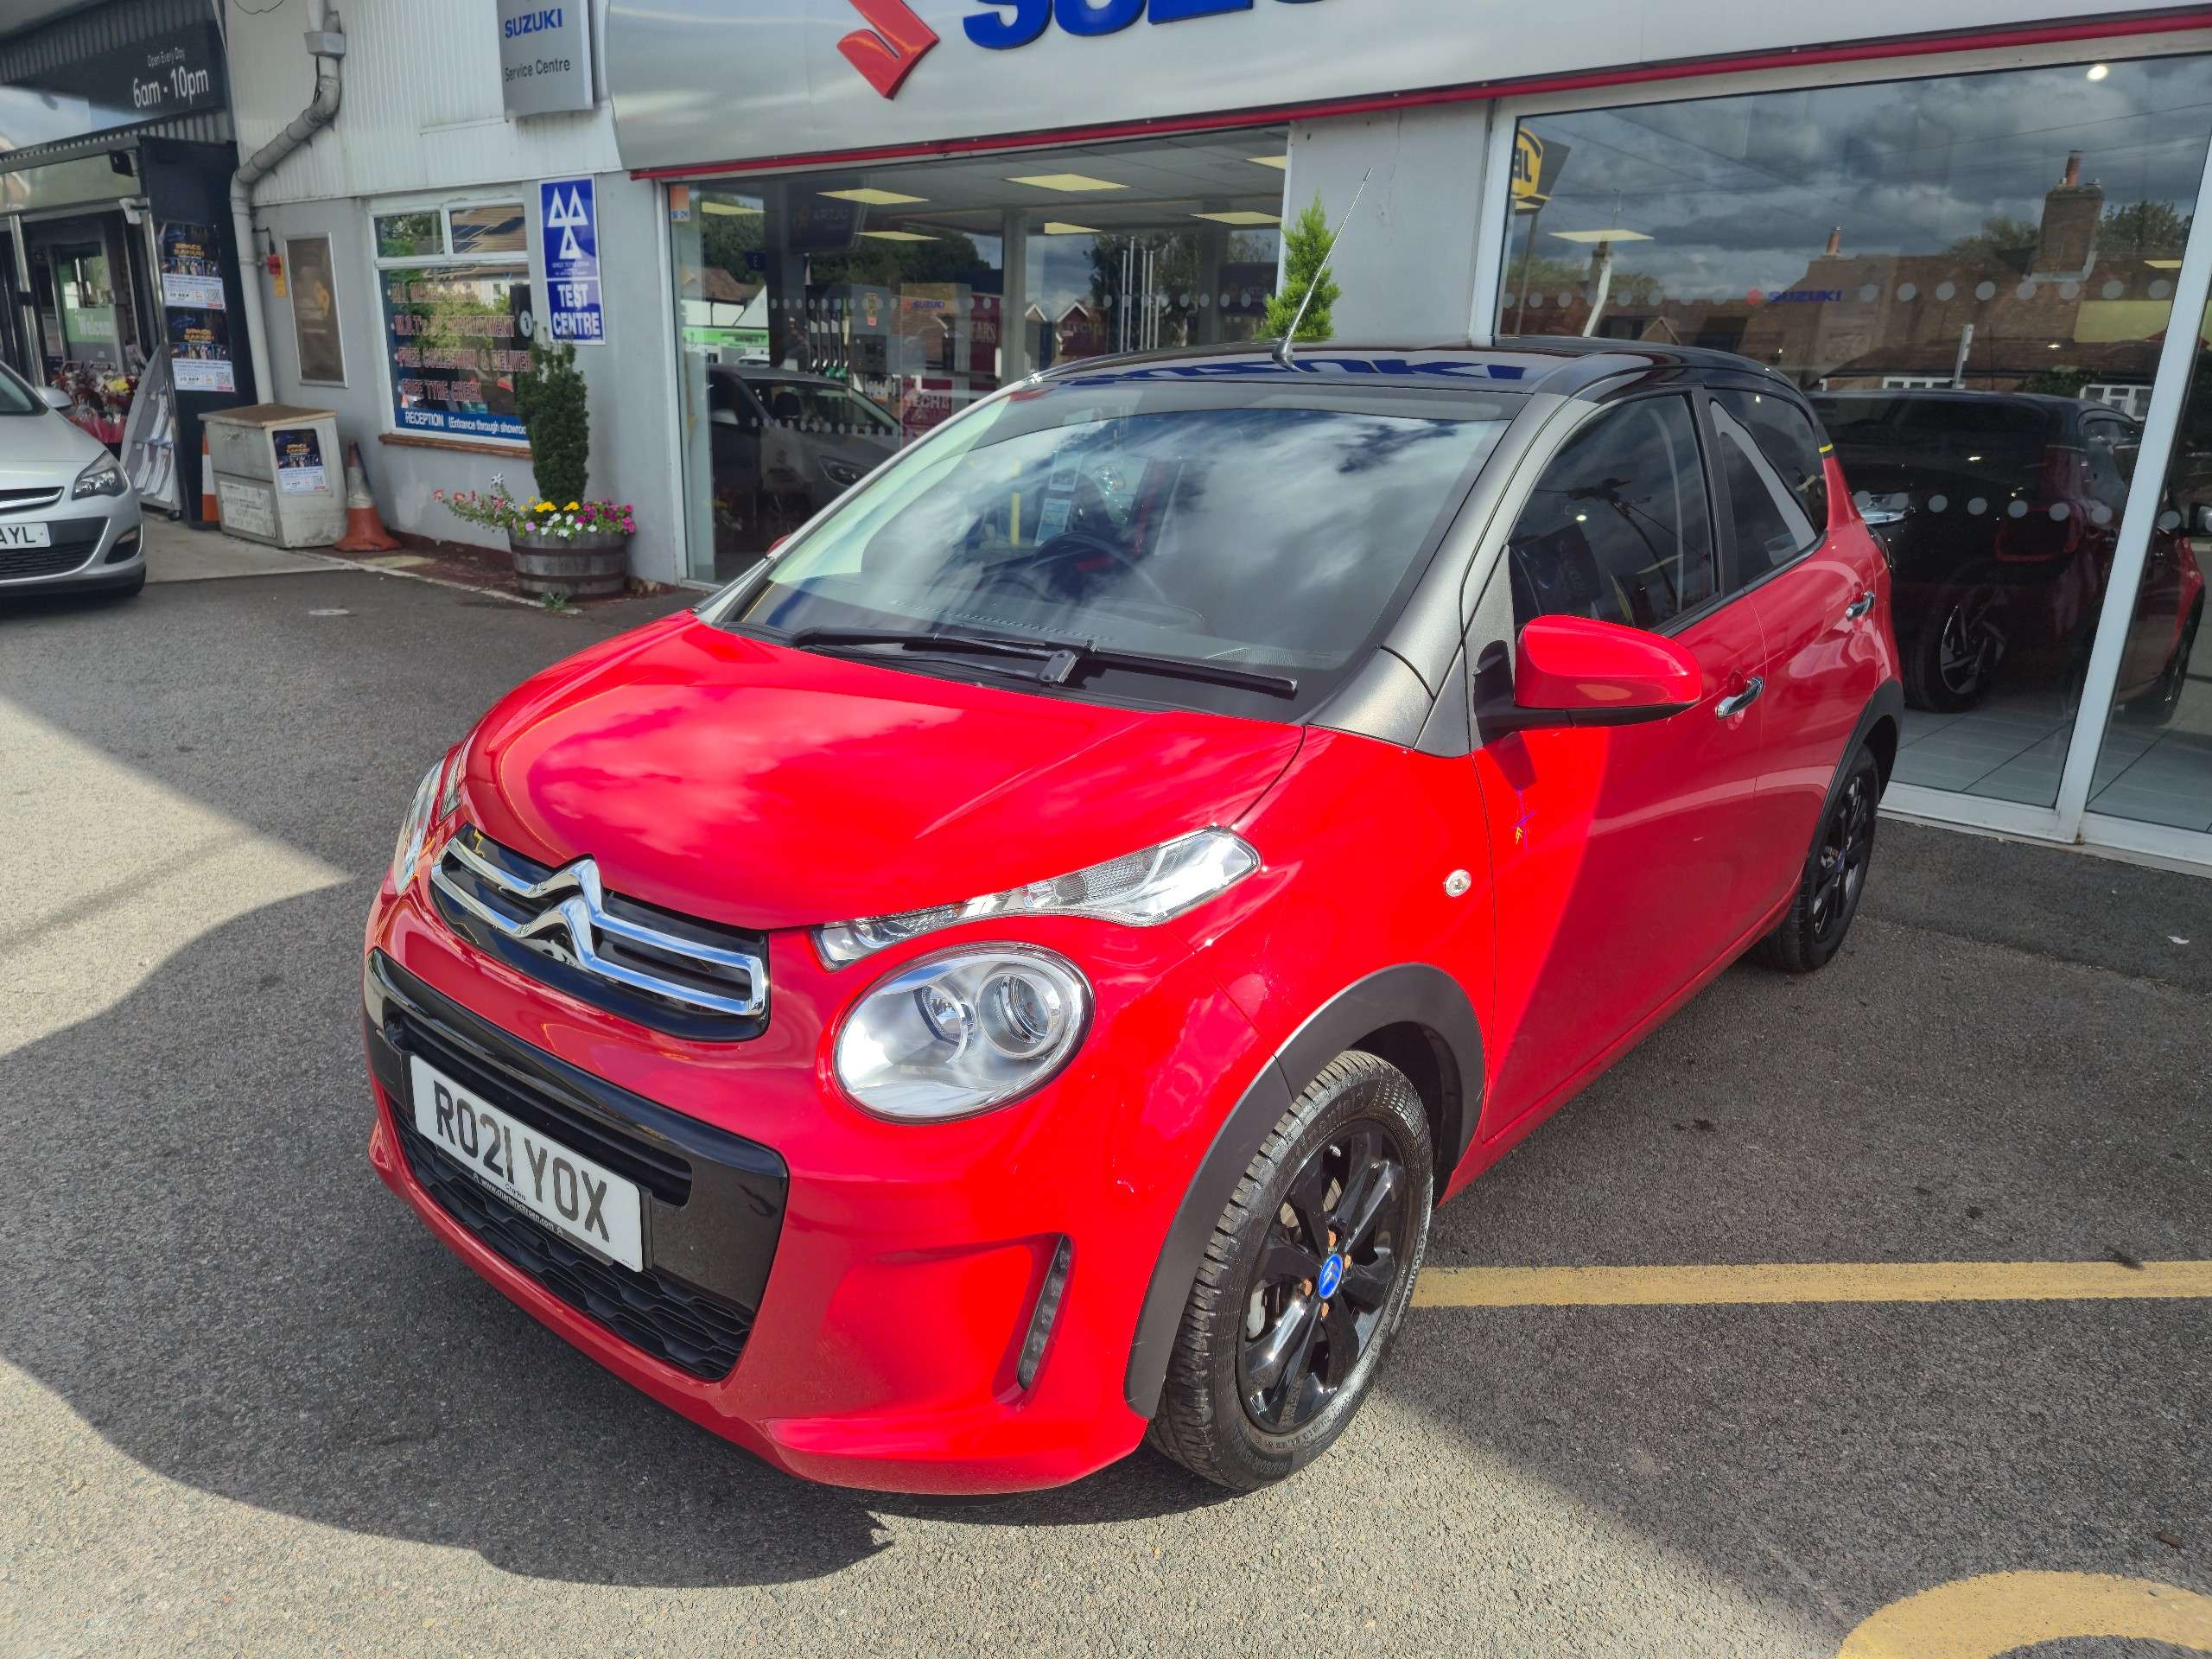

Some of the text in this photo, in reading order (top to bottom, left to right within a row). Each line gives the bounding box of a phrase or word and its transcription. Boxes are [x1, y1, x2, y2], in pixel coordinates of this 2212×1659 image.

[505, 8, 563, 38] SUZUKI
[505, 58, 570, 82] Service Centre
[132, 77, 162, 108] 6am
[170, 66, 209, 105] 10pm
[557, 283, 588, 308] TEST
[1769, 289, 1842, 303] SUZUKI
[552, 311, 601, 336] CENTRE
[398, 347, 422, 368] FREE
[423, 347, 477, 370] COLLECTION
[401, 378, 484, 403] FREE TYRE CHECK
[405, 411, 444, 428] RECEPTION
[475, 420, 500, 435] through
[434, 1079, 610, 1243] RO21 YOX
